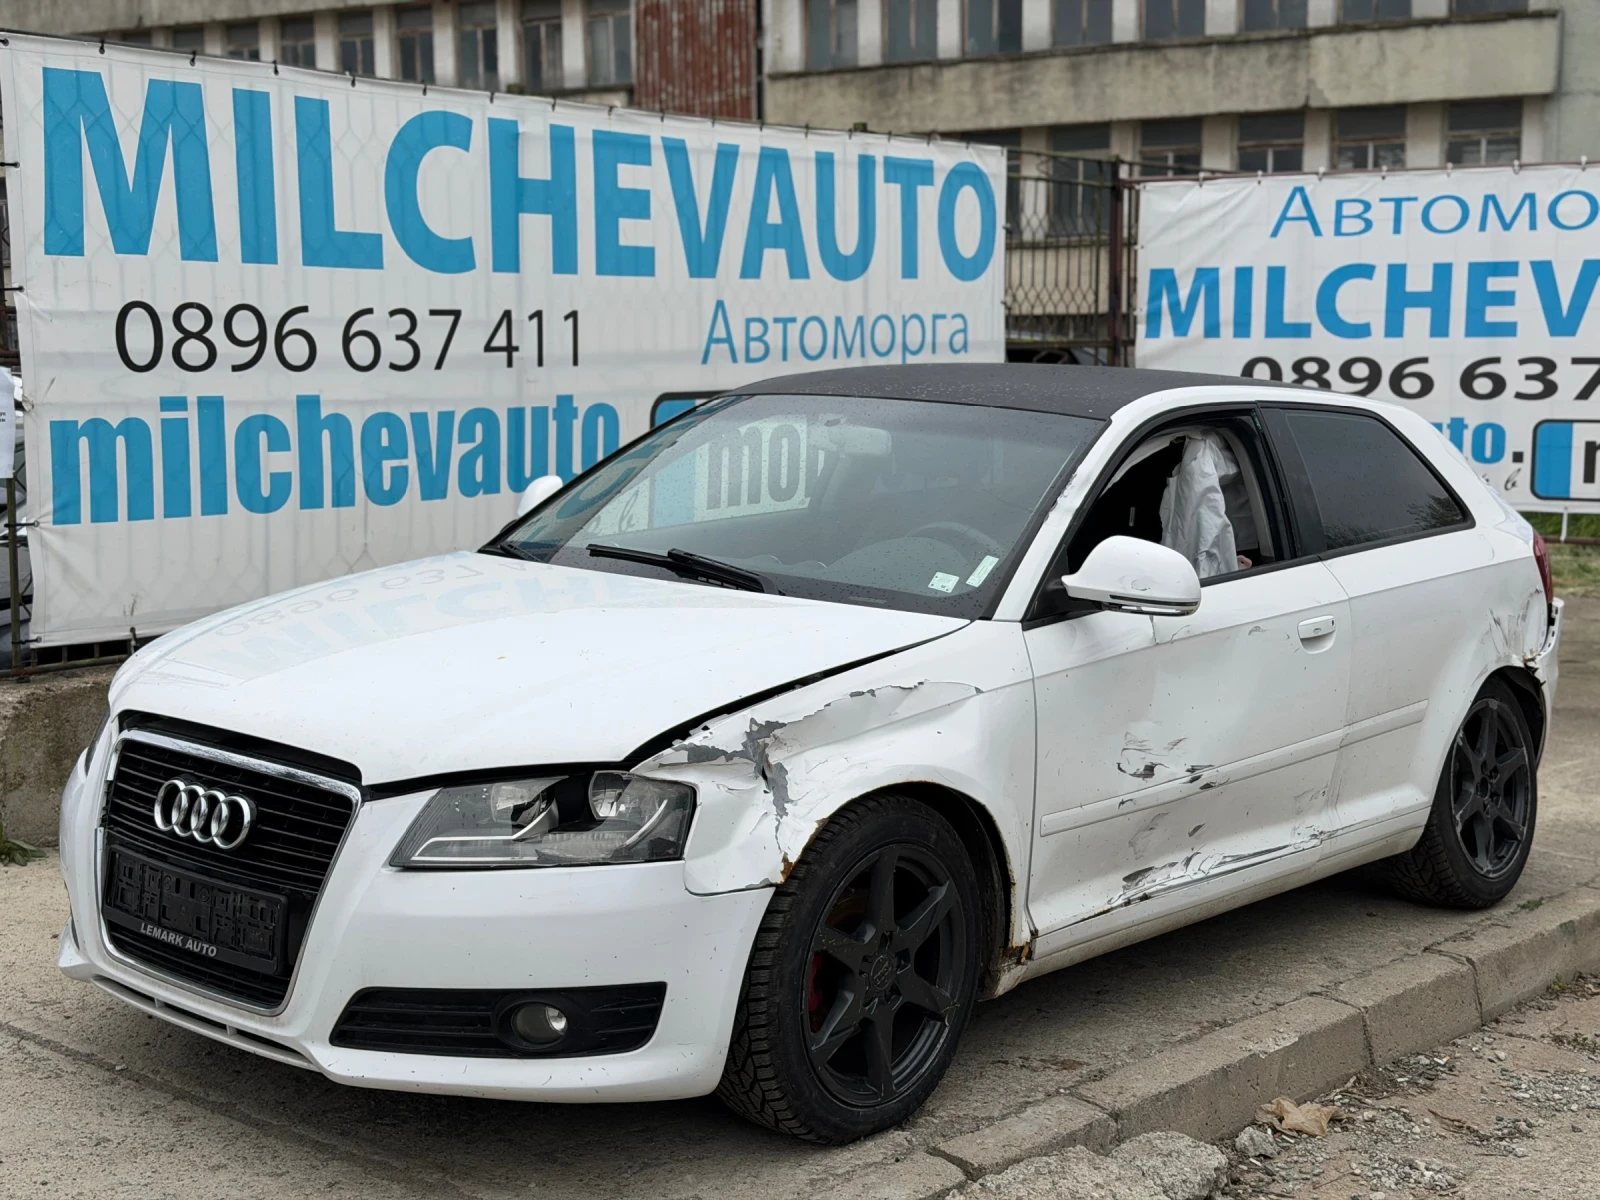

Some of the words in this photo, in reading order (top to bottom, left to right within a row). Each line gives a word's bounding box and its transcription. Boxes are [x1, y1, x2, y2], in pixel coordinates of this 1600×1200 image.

[43, 67, 997, 281] MILCHEVAUTO
[701, 299, 969, 364] Автоморга
[1145, 259, 1600, 339] MILCHEV
[115, 301, 318, 373] 0896
[341, 307, 462, 372] 637
[483, 309, 580, 369] 411
[1459, 356, 1600, 401] 637
[49, 394, 620, 526] milchevauto
[140, 922, 183, 946] LEMARK
[186, 939, 217, 957] AUTO
